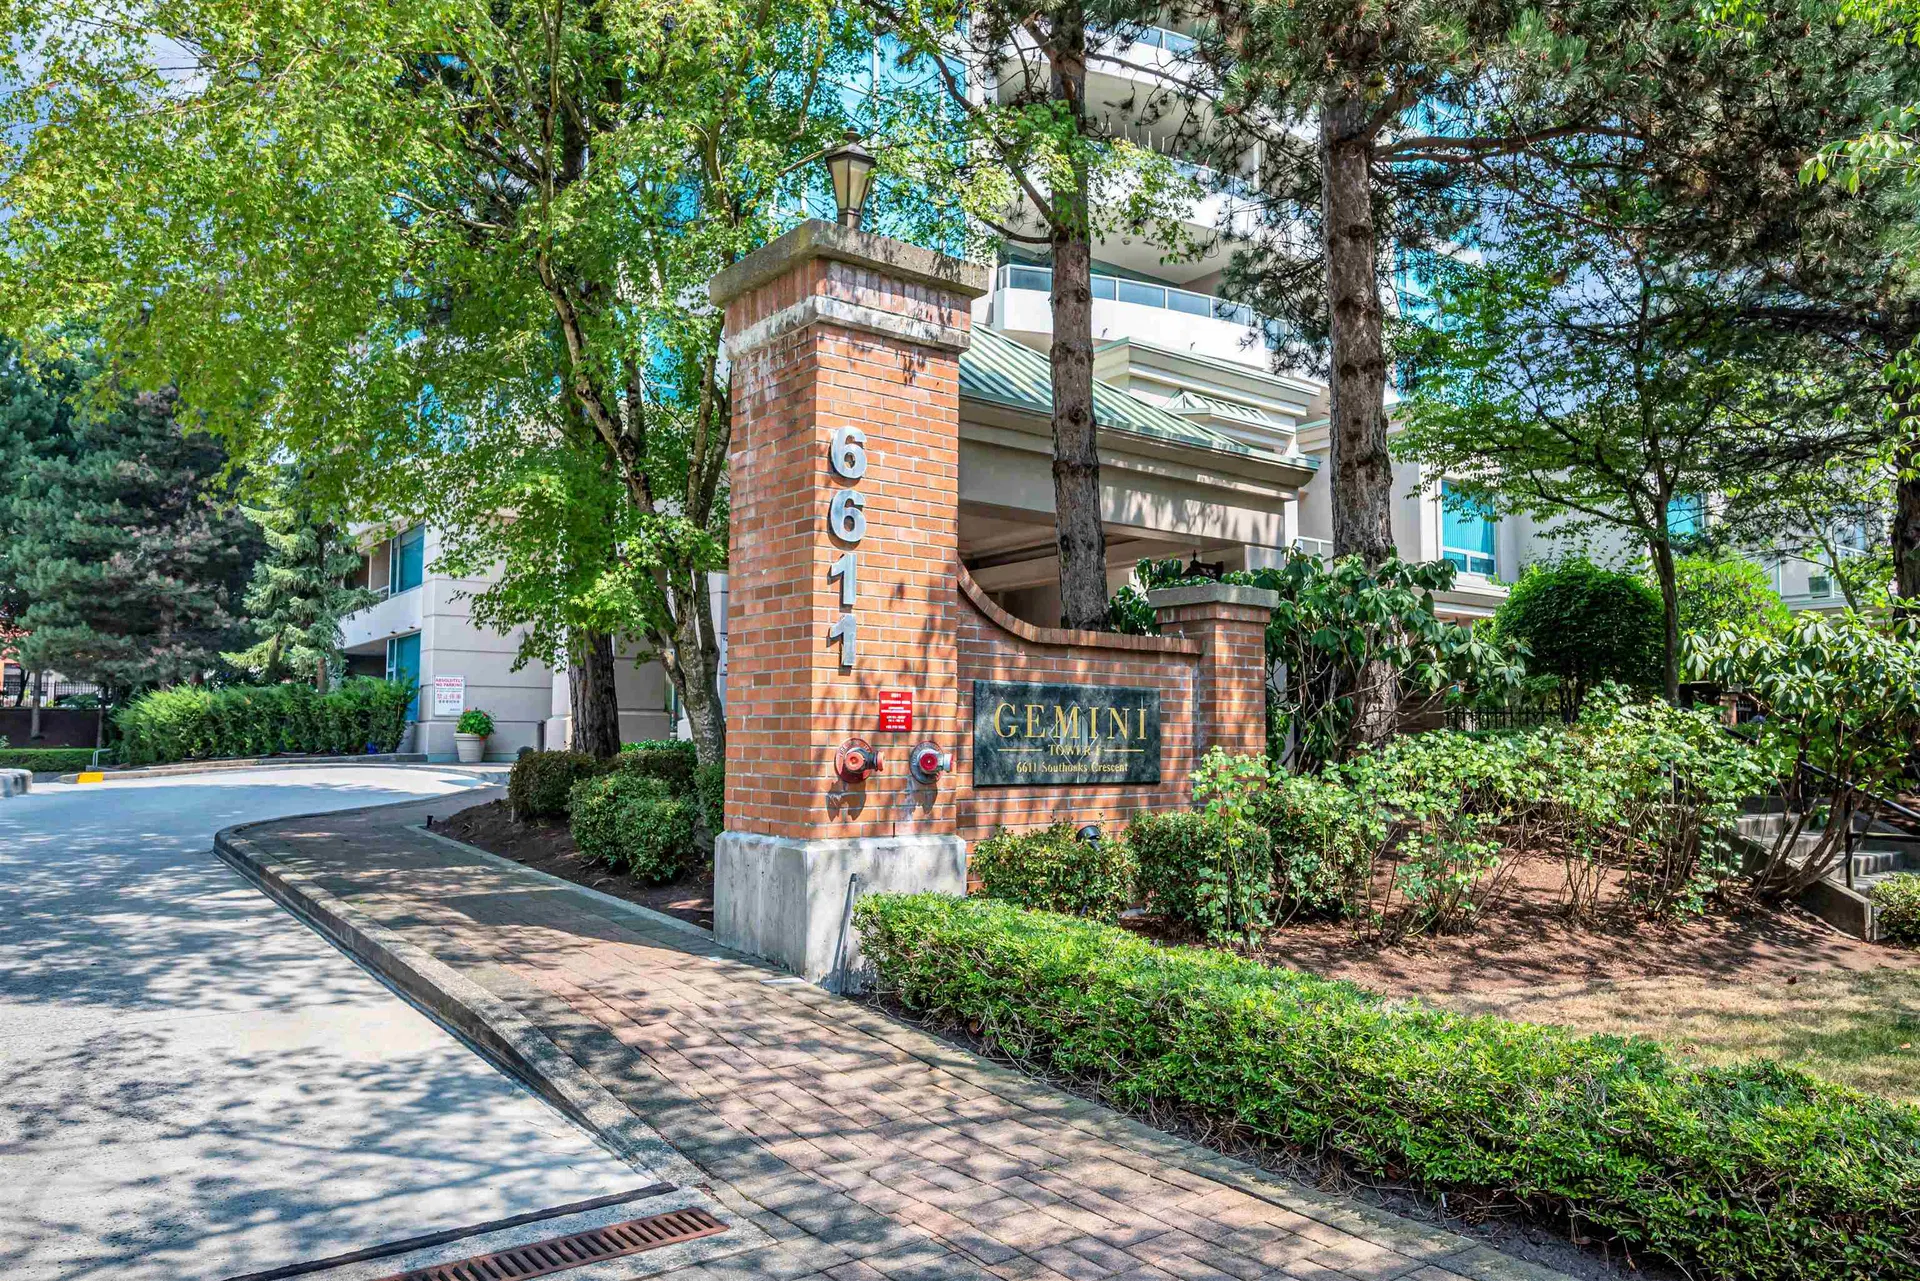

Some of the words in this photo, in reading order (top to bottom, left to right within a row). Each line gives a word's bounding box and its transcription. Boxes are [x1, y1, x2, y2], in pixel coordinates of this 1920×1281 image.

[993, 702, 1148, 740] GEMINI
[1048, 744, 1091, 757] TOWER
[1016, 761, 1037, 773] 6611
[1041, 761, 1088, 773] Southoaks
[1091, 762, 1129, 773] Crescent
